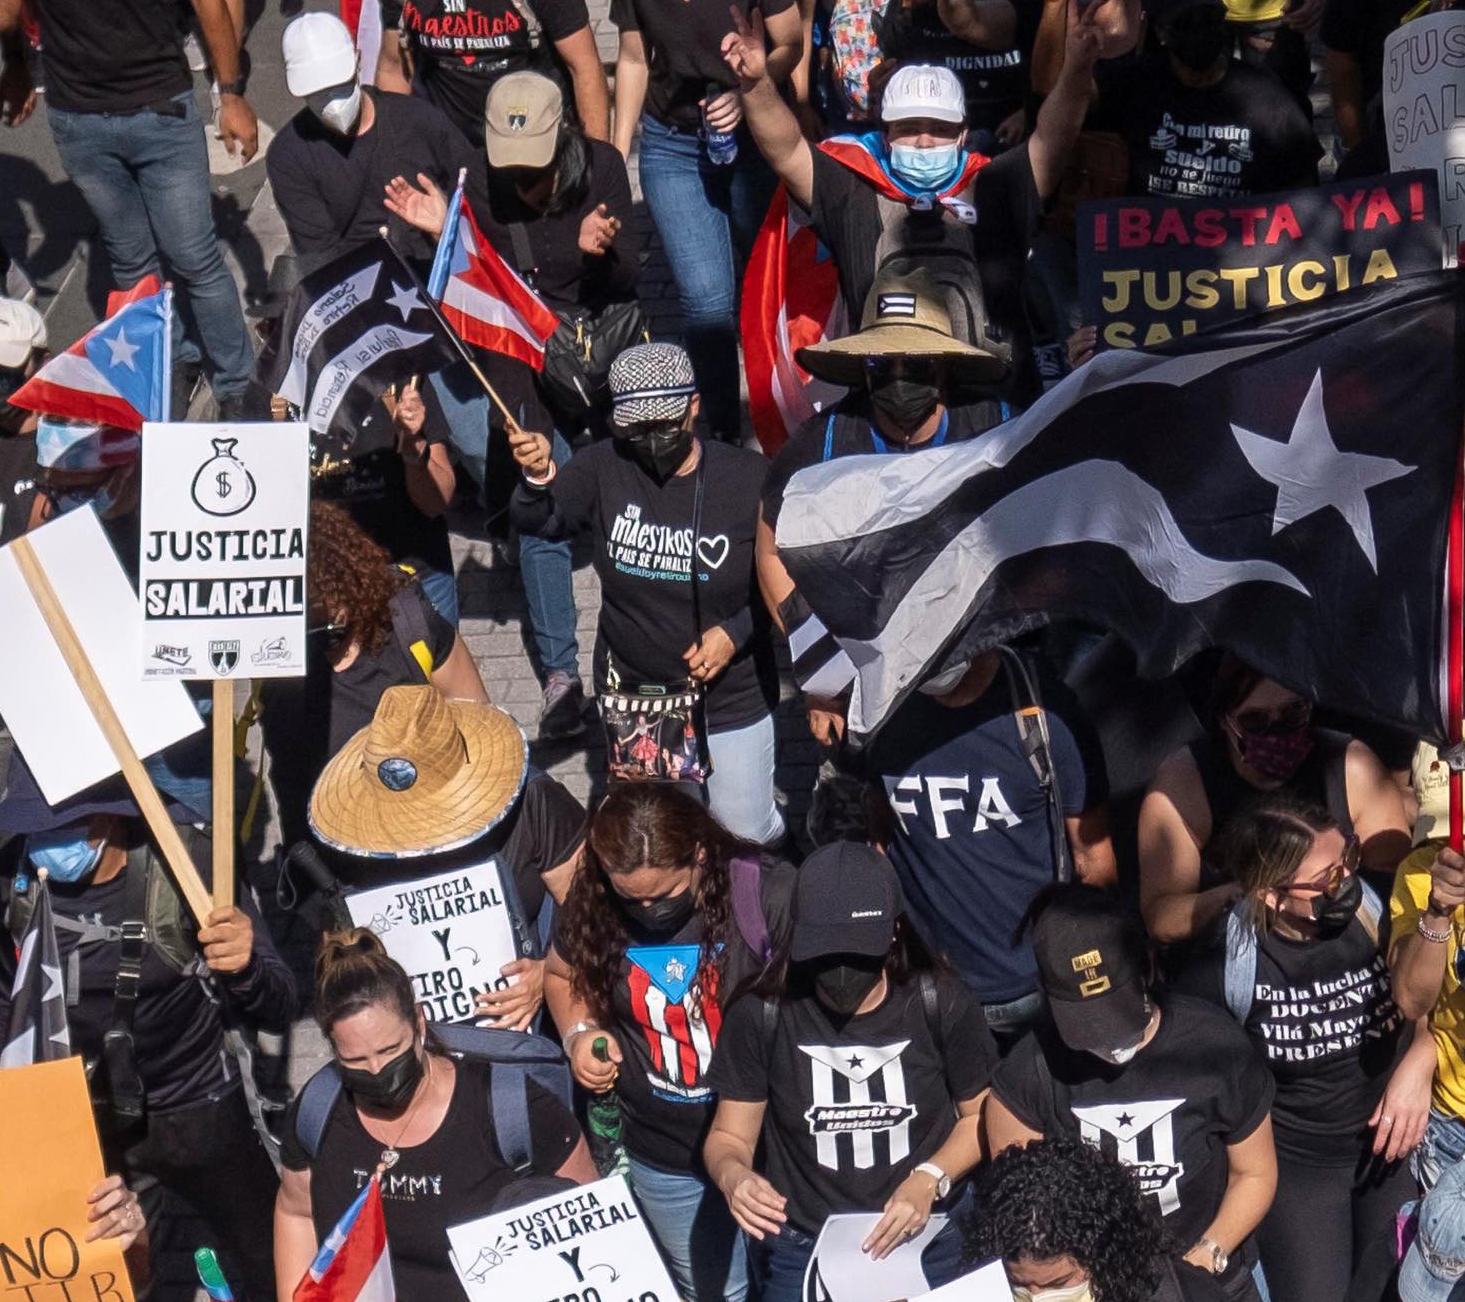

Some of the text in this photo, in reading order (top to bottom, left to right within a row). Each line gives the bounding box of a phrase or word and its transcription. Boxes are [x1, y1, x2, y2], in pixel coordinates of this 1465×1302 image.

[944, 49, 1021, 72] DIGNIDAD
[1102, 249, 1397, 314] JUSTICIA
[146, 527, 304, 563] JUSTICIA
[146, 577, 303, 618] SALARIAL
[1256, 969, 1370, 1003] En la lucha
[816, 1106, 906, 1128] Maestro
[508, 1194, 599, 1242] JUSTICIA
[525, 1199, 637, 1250] SALARIAL
[0, 1228, 79, 1284] NO
[559, 1249, 581, 1284] Y
